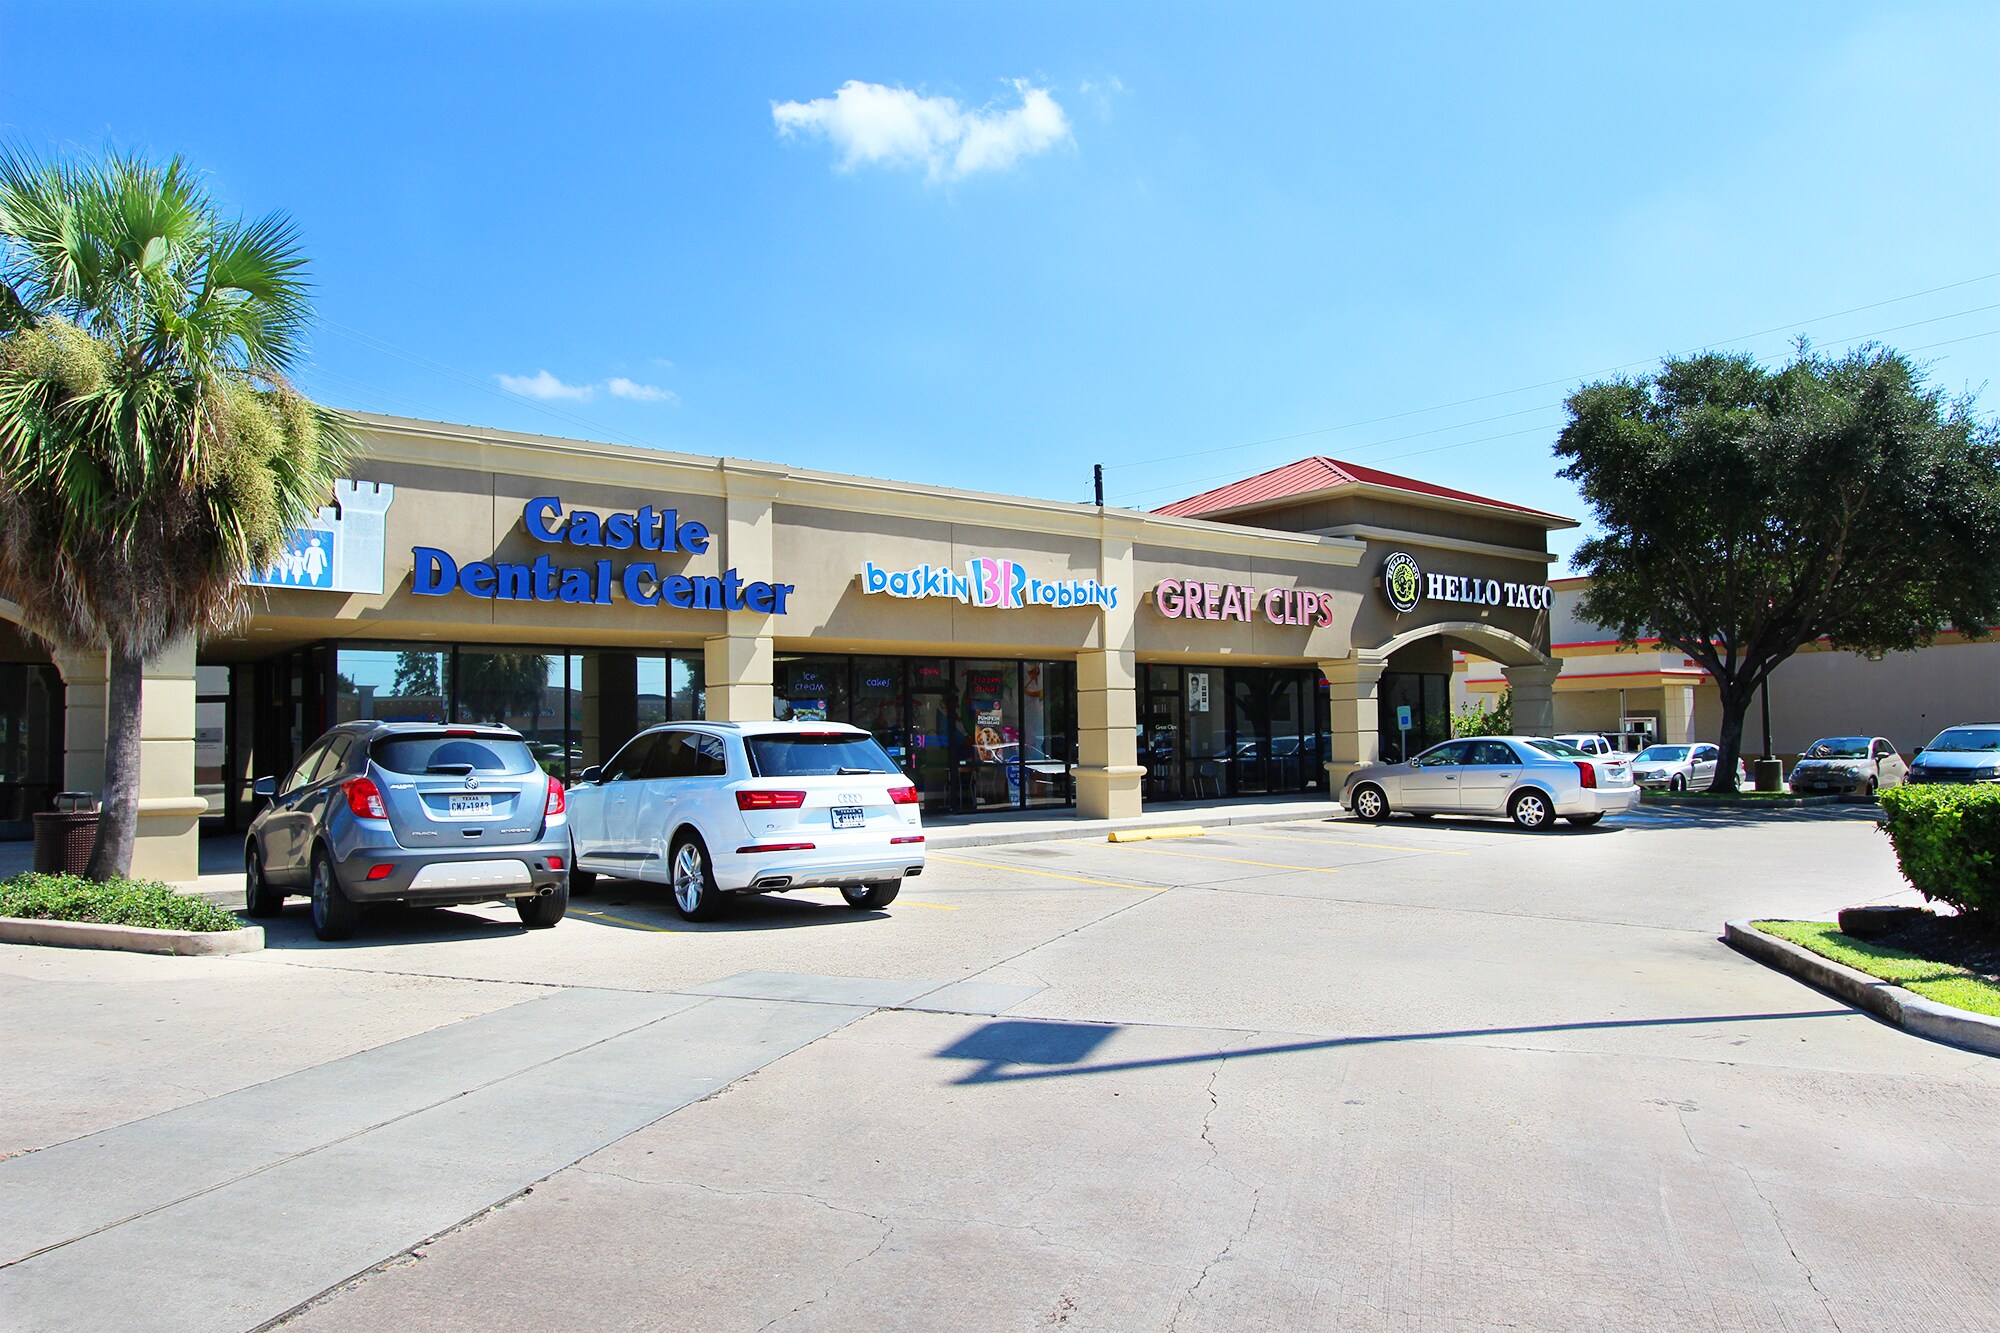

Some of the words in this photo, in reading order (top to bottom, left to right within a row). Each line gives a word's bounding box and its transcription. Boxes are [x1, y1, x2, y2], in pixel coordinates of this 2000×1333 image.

[523, 496, 710, 555] Castle
[411, 546, 613, 606] Dental
[623, 561, 795, 615] Center
[863, 560, 969, 603] baskin
[968, 557, 1026, 609] BR
[1030, 578, 1118, 611] robbins
[1388, 556, 1405, 580] HELLO
[1405, 557, 1419, 580] TACO
[1154, 578, 1255, 623] GREAT
[1262, 587, 1334, 629] CLIPS
[1426, 572, 1501, 606] HELLO
[1504, 582, 1556, 610] TACO
[794, 682, 824, 691] cream
[803, 671, 816, 681] ice
